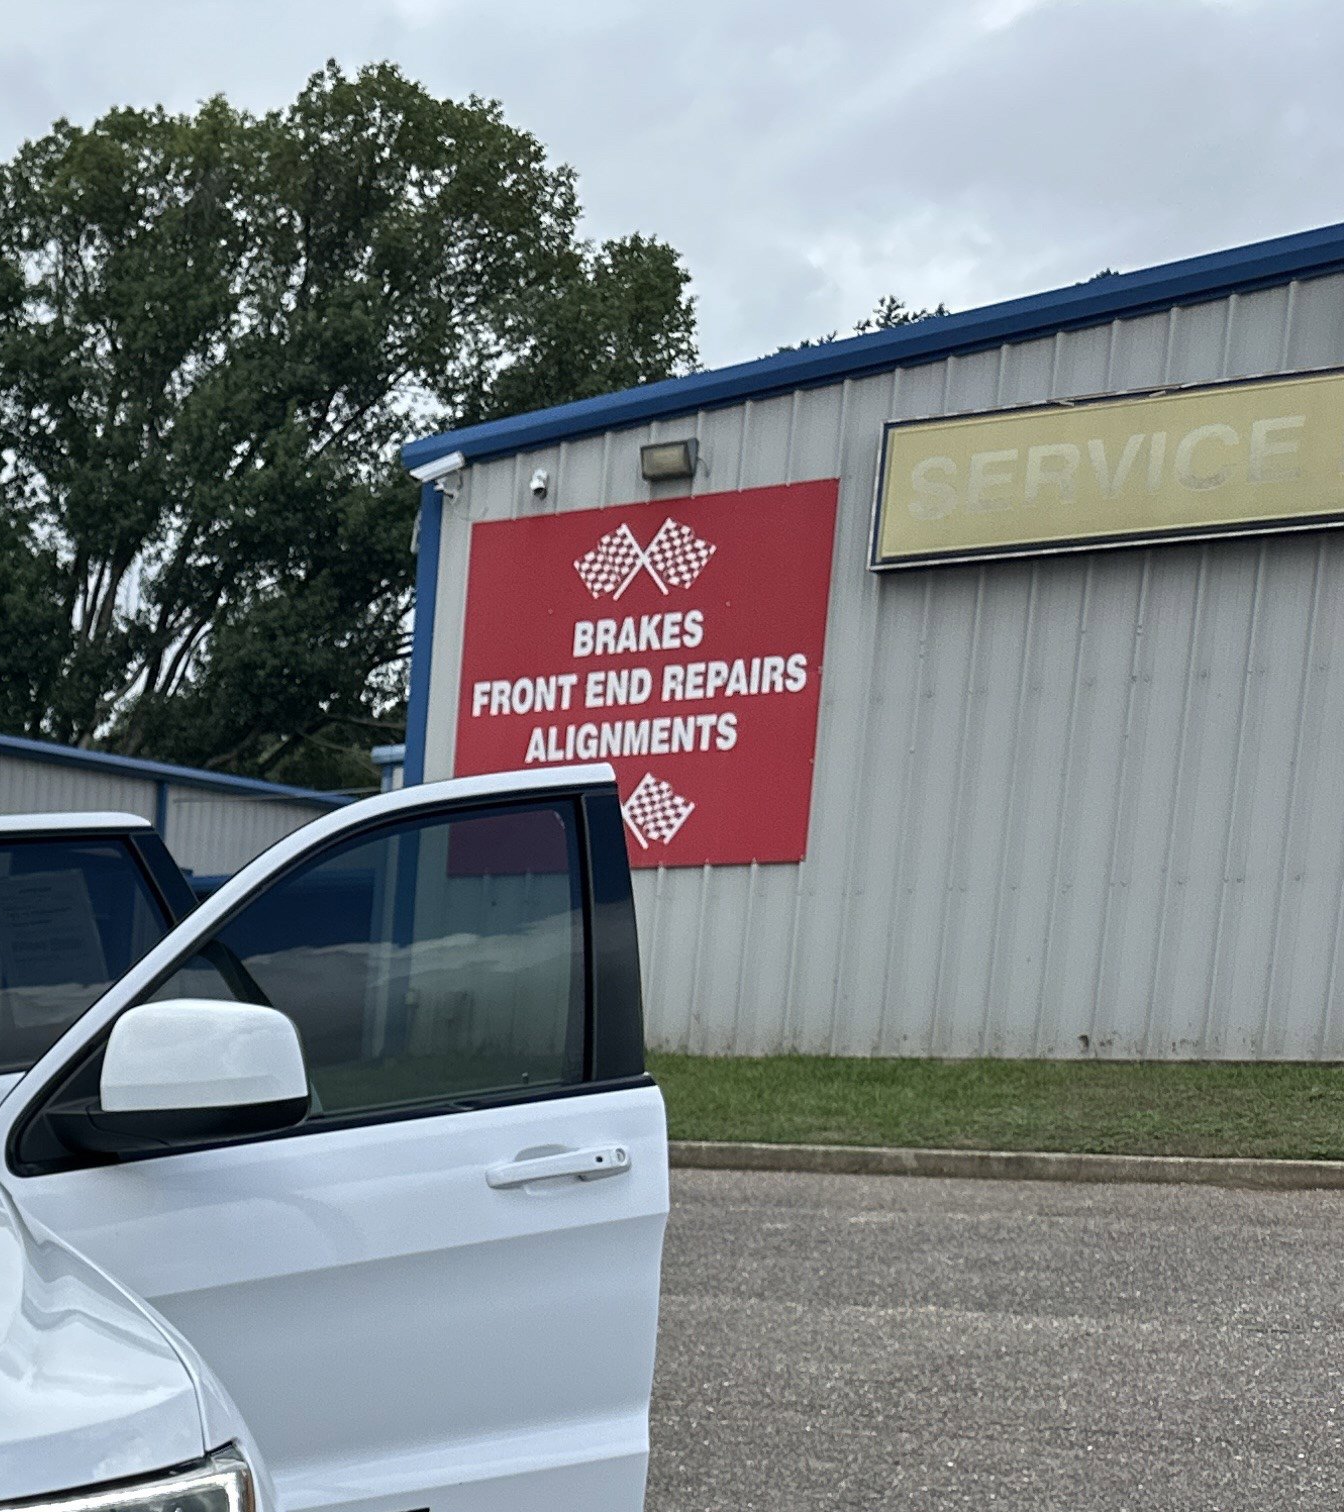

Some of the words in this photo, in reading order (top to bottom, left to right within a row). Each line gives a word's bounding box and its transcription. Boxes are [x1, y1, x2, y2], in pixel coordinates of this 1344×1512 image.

[908, 414, 1307, 521] SERVICE
[572, 609, 704, 658] BRAKES
[472, 674, 578, 717] FRONT
[584, 667, 652, 709] END
[661, 653, 808, 702] REPAIRS
[524, 712, 738, 763] ALIGNMENTS
